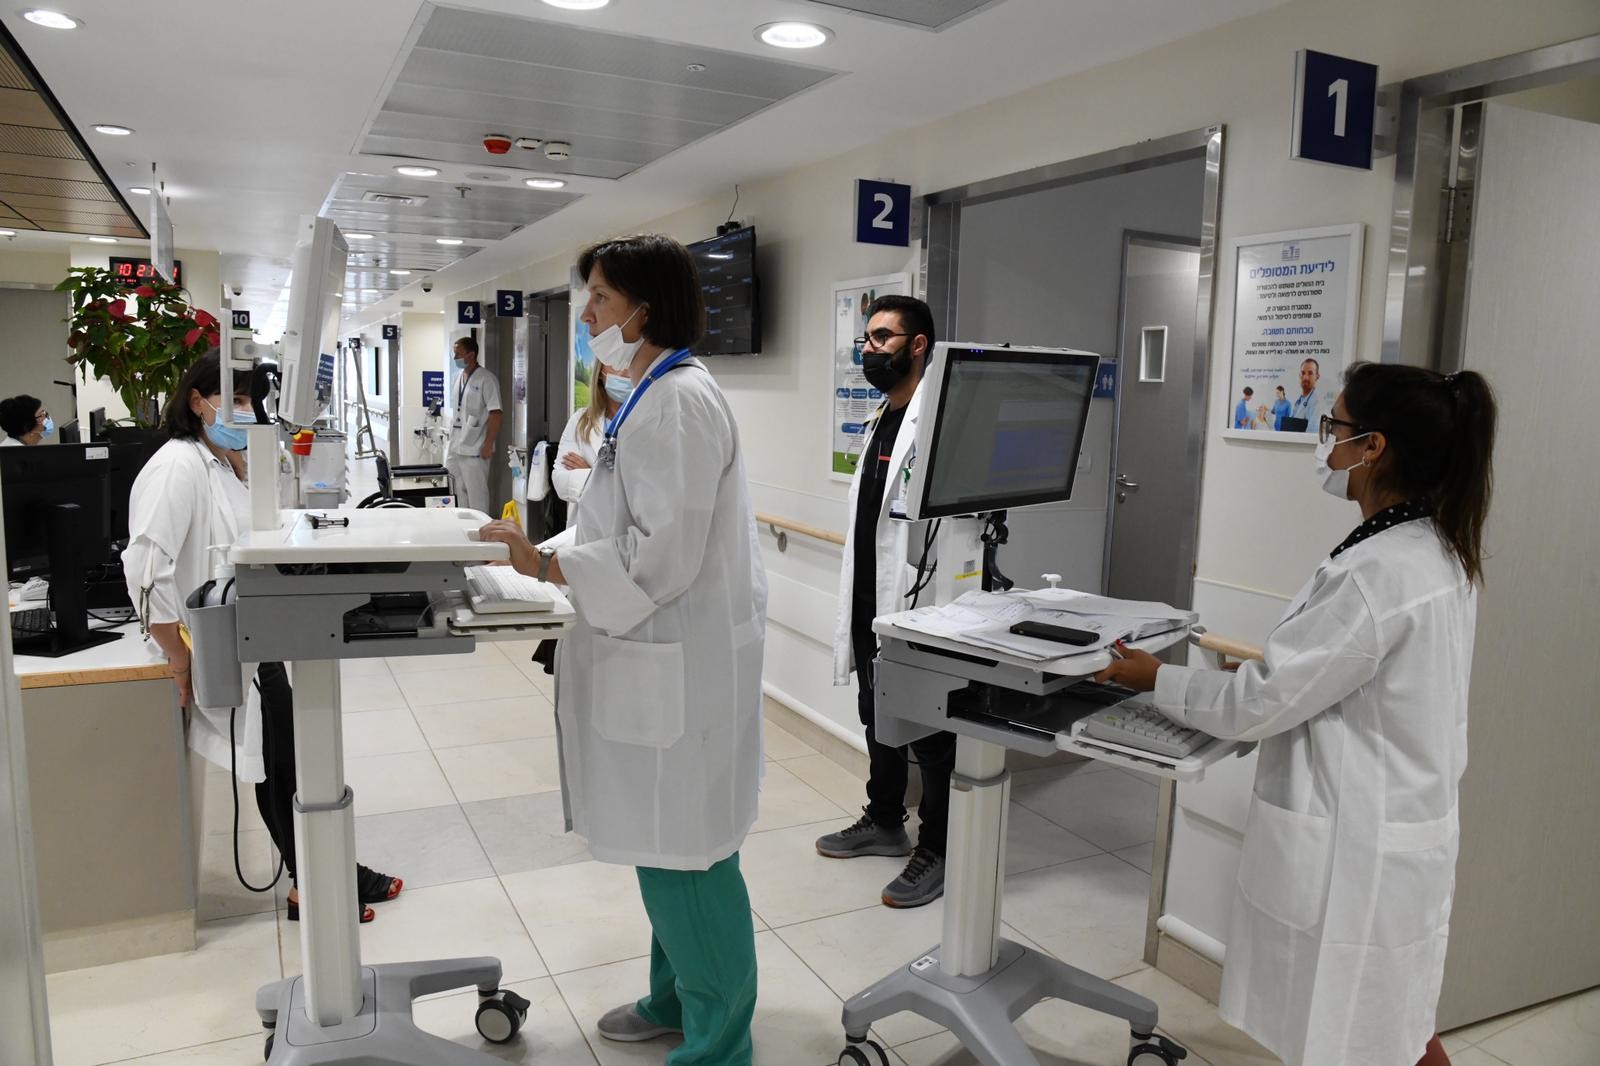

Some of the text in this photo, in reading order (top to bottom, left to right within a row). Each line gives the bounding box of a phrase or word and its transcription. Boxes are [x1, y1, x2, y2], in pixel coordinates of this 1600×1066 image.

[1328, 78, 1348, 137] 1
[872, 192, 893, 230] 2
[1250, 260, 1335, 279] לידיעת המטופלים
[504, 295, 515, 311] 3
[233, 314, 248, 325] 10
[464, 305, 475, 319] 4
[386, 328, 393, 336] 5
